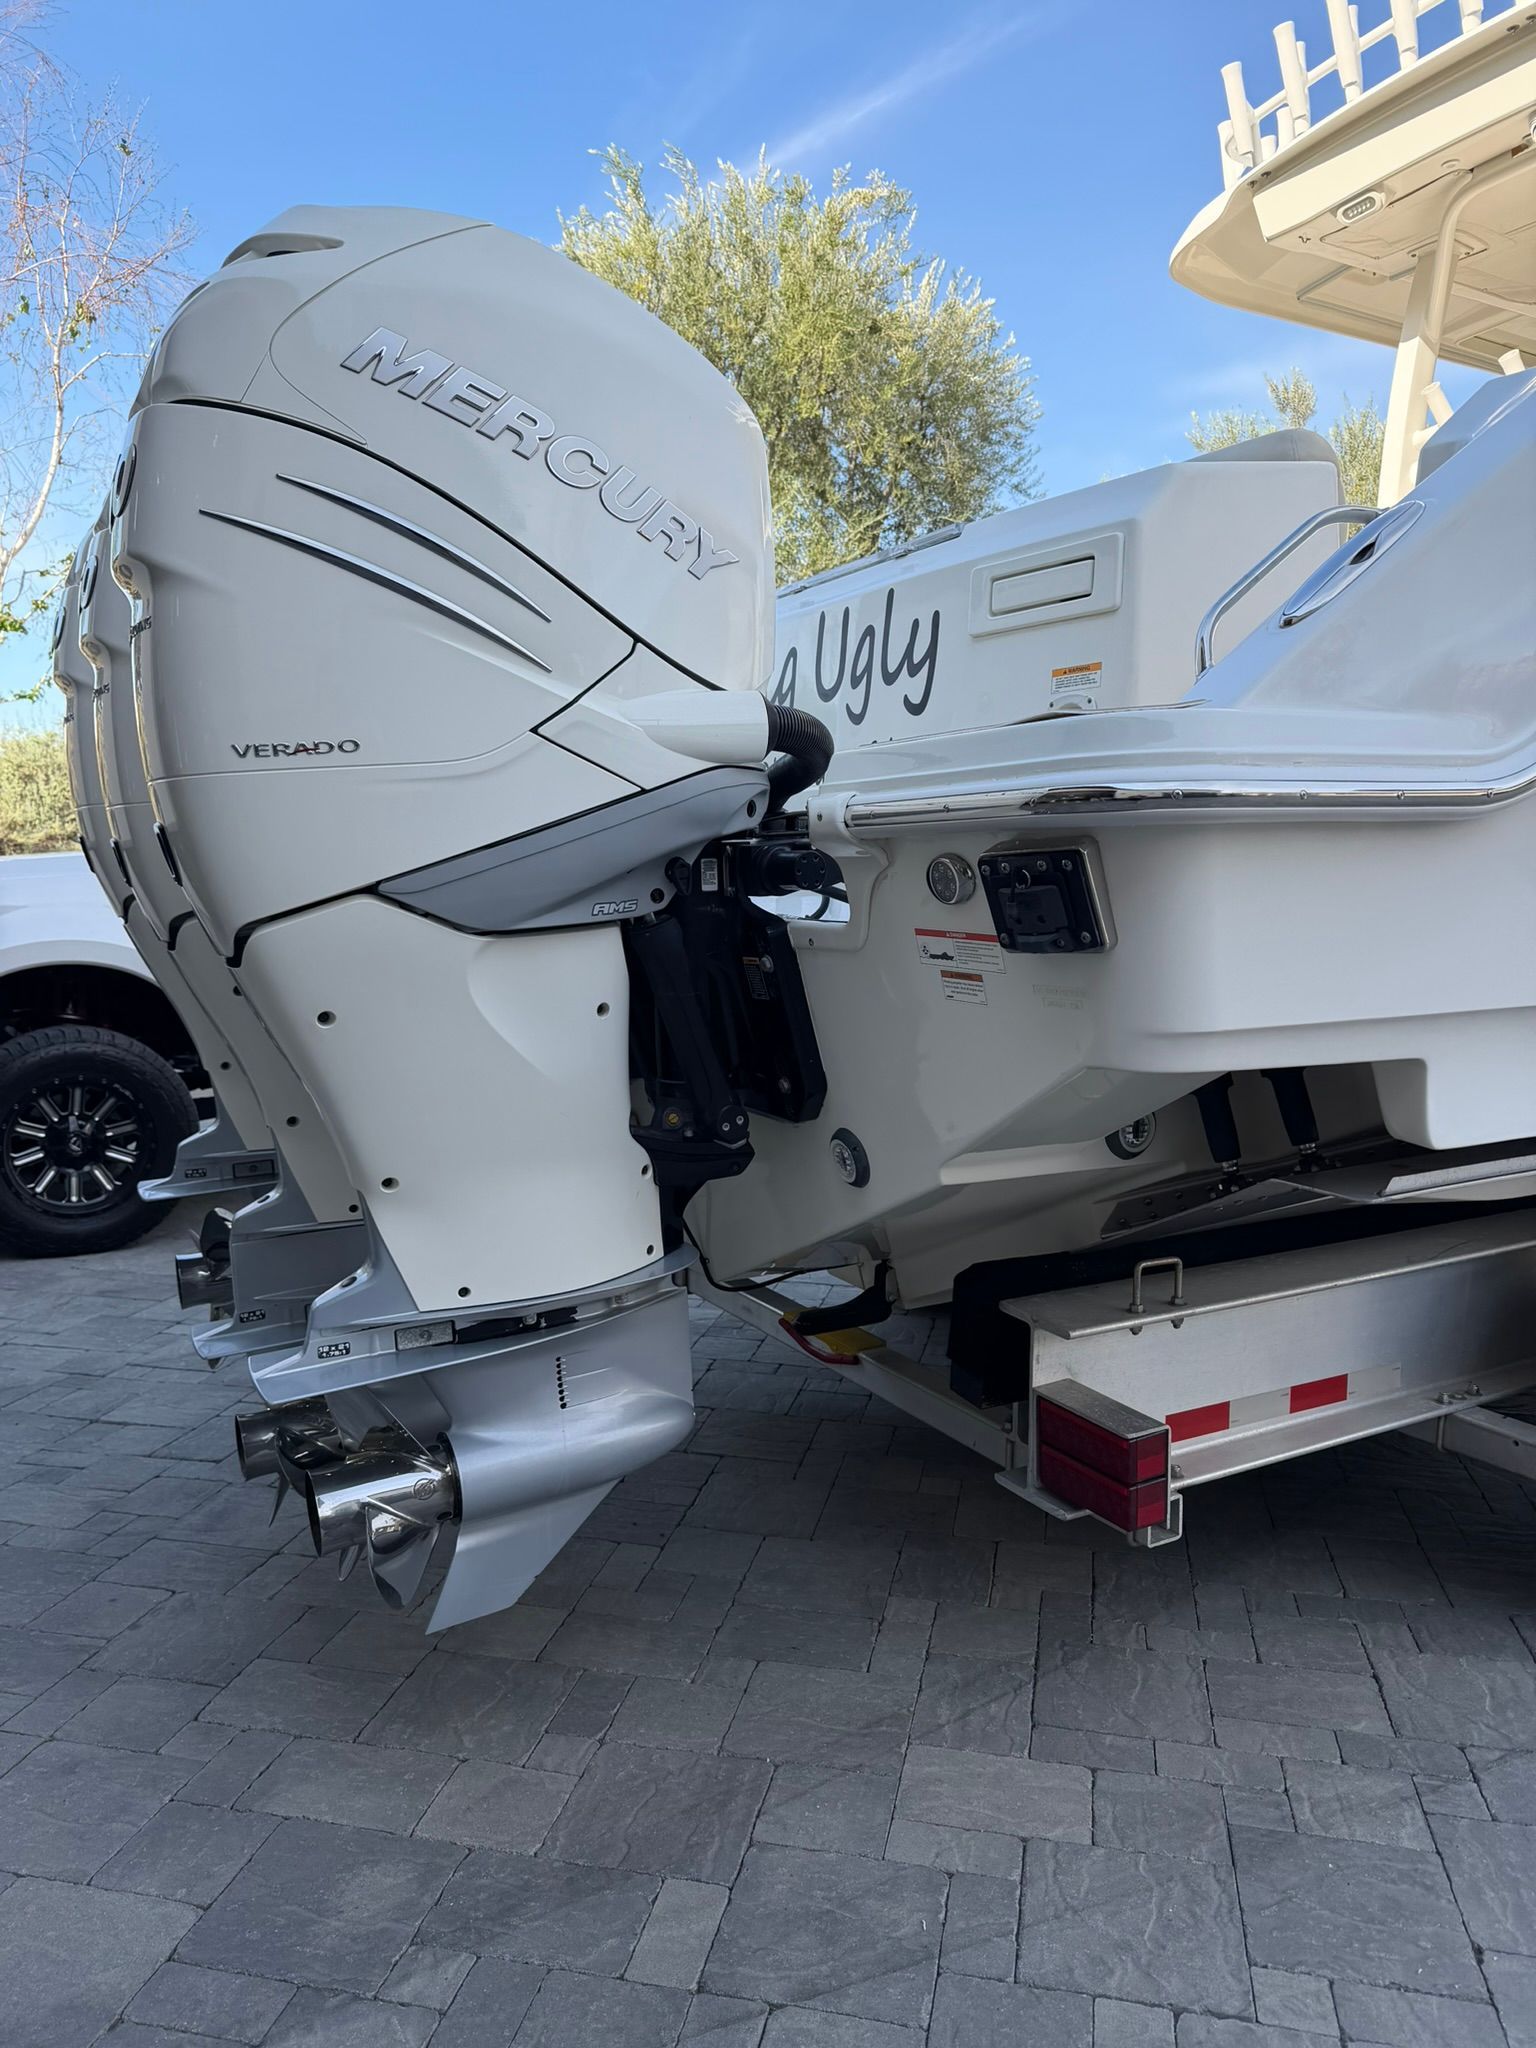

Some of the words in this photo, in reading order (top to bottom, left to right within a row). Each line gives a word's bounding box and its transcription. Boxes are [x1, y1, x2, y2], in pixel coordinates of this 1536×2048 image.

[340, 326, 739, 580] MERCURY
[815, 587, 940, 726] Ugly
[231, 739, 360, 758] VERADO
[592, 899, 638, 916] AMS
